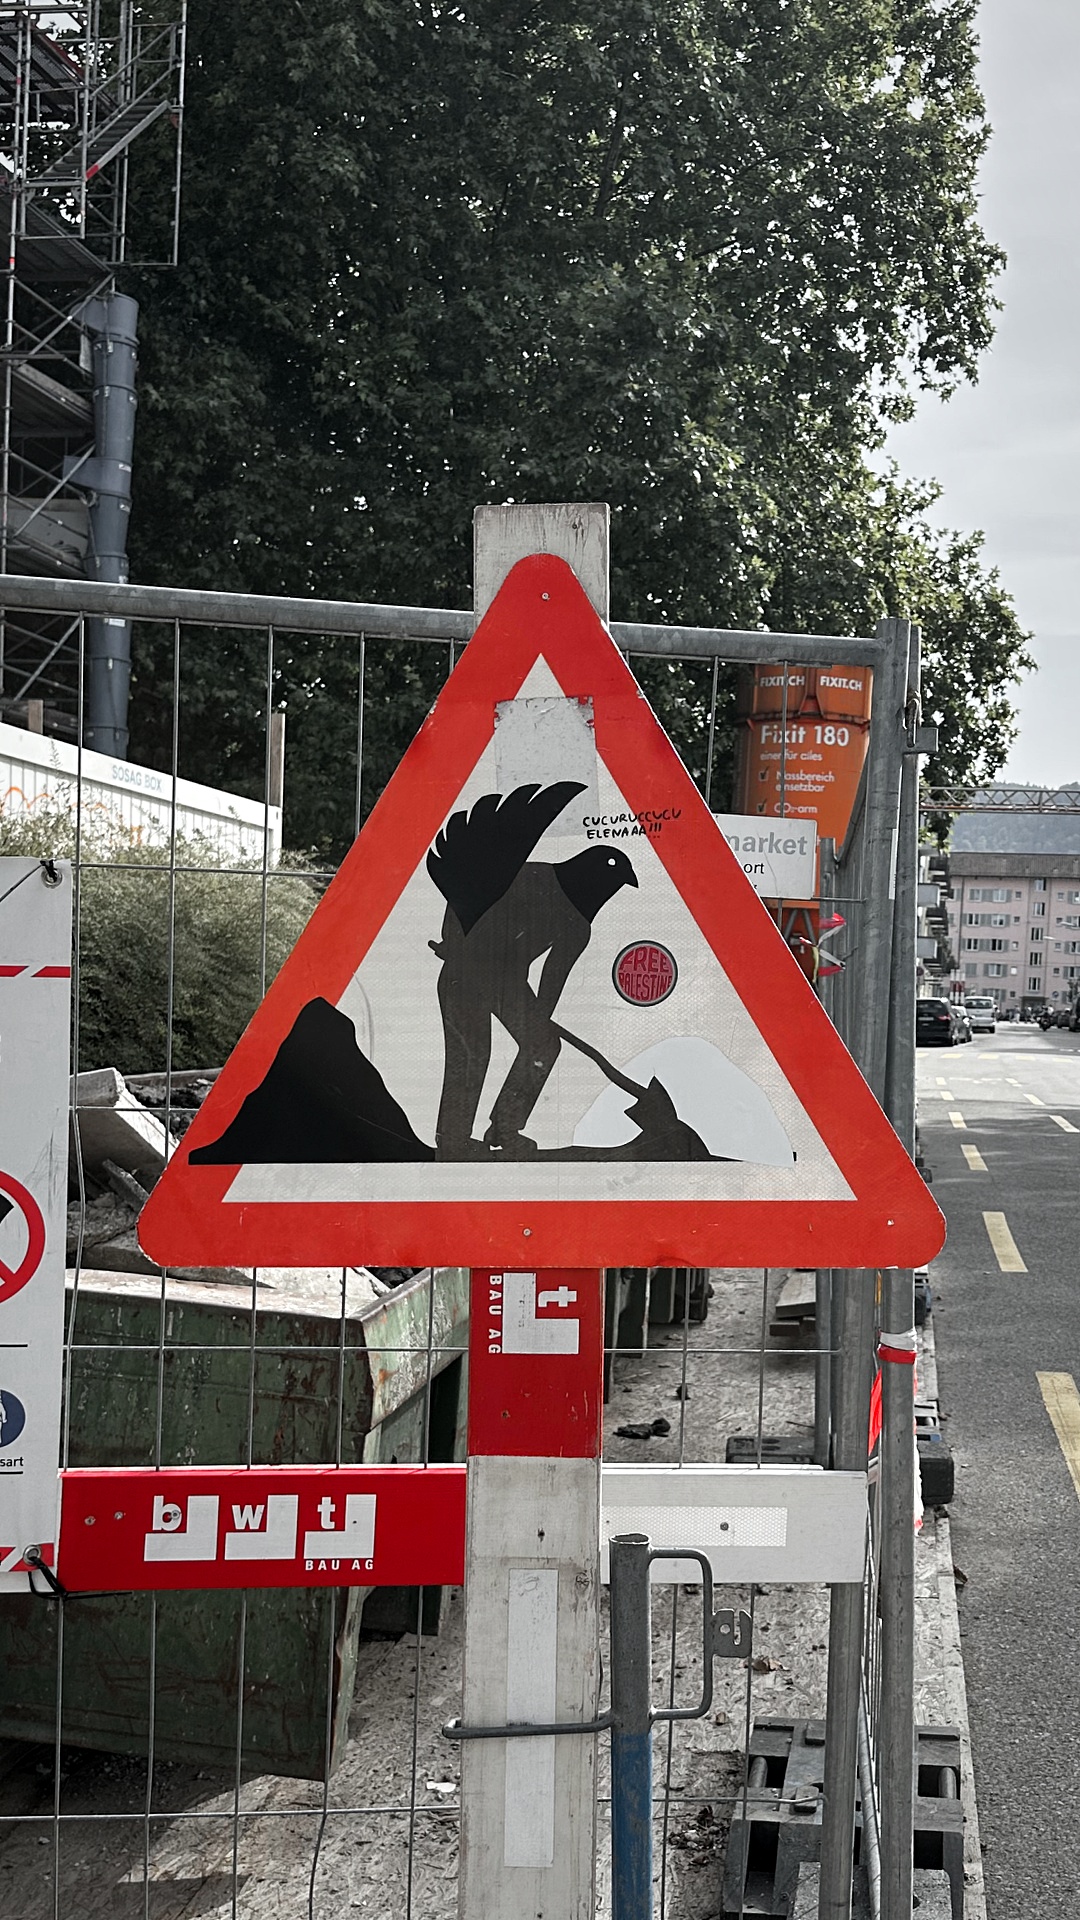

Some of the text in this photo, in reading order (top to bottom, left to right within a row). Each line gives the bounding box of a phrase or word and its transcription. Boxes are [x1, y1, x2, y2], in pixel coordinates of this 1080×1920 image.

[760, 675, 805, 687] FIXITCH
[820, 675, 863, 691] FIXIT.CH
[761, 724, 849, 747] Fixit 180
[112, 764, 163, 792] SOSAG BOX
[775, 781, 825, 792] ensetzbar
[618, 946, 670, 973] FREE
[618, 972, 673, 1000] PALESTINE
[488, 1275, 502, 1354] BAU AG
[305, 1559, 374, 1571] BAU AG
